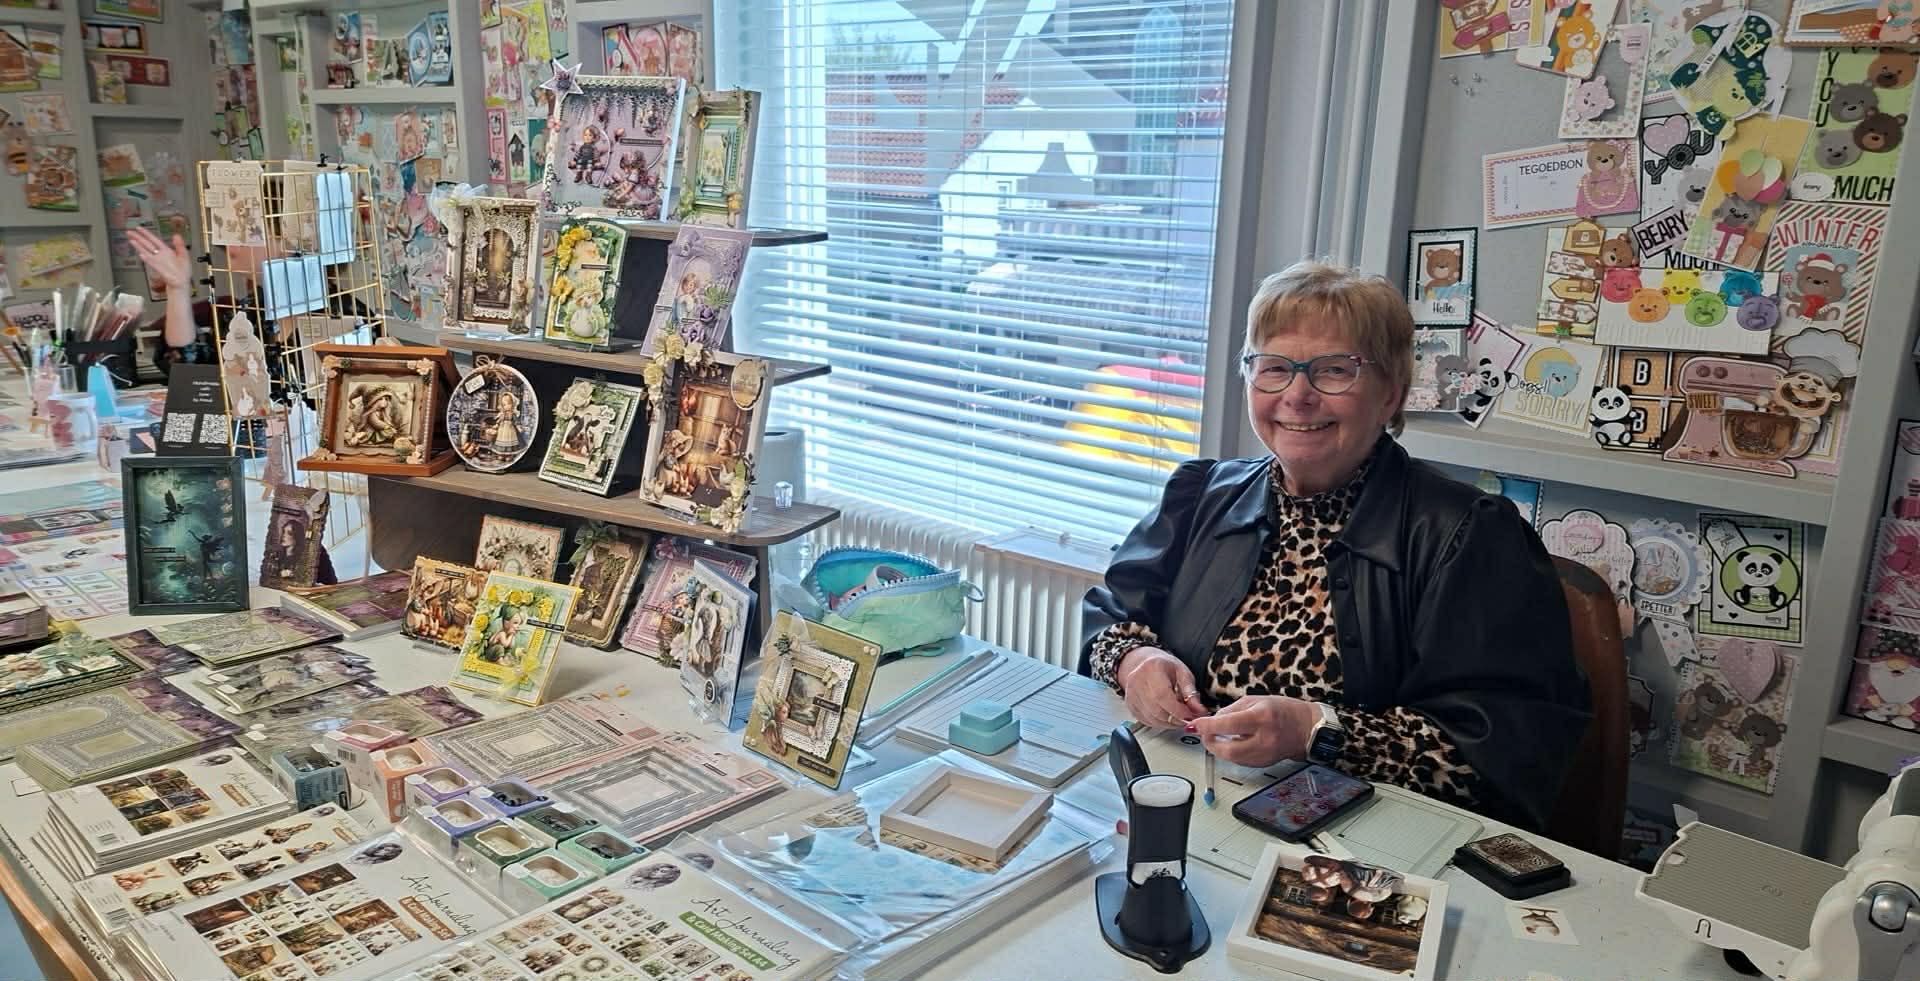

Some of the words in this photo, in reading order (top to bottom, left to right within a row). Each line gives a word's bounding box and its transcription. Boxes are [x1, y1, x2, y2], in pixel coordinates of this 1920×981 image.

[1519, 159, 1584, 176] TEGOEDBON
[1832, 175, 1895, 201] MUCH
[1637, 210, 1689, 251] BEARY
[1776, 218, 1880, 252] WINTER
[1633, 358, 1652, 386] B
[1514, 391, 1587, 425] SORRY
[1688, 392, 1717, 409] SWEET
[400, 875, 433, 893] Art
[690, 898, 732, 917] Art
[715, 916, 801, 972] Journaling
[708, 930, 744, 951] Making
